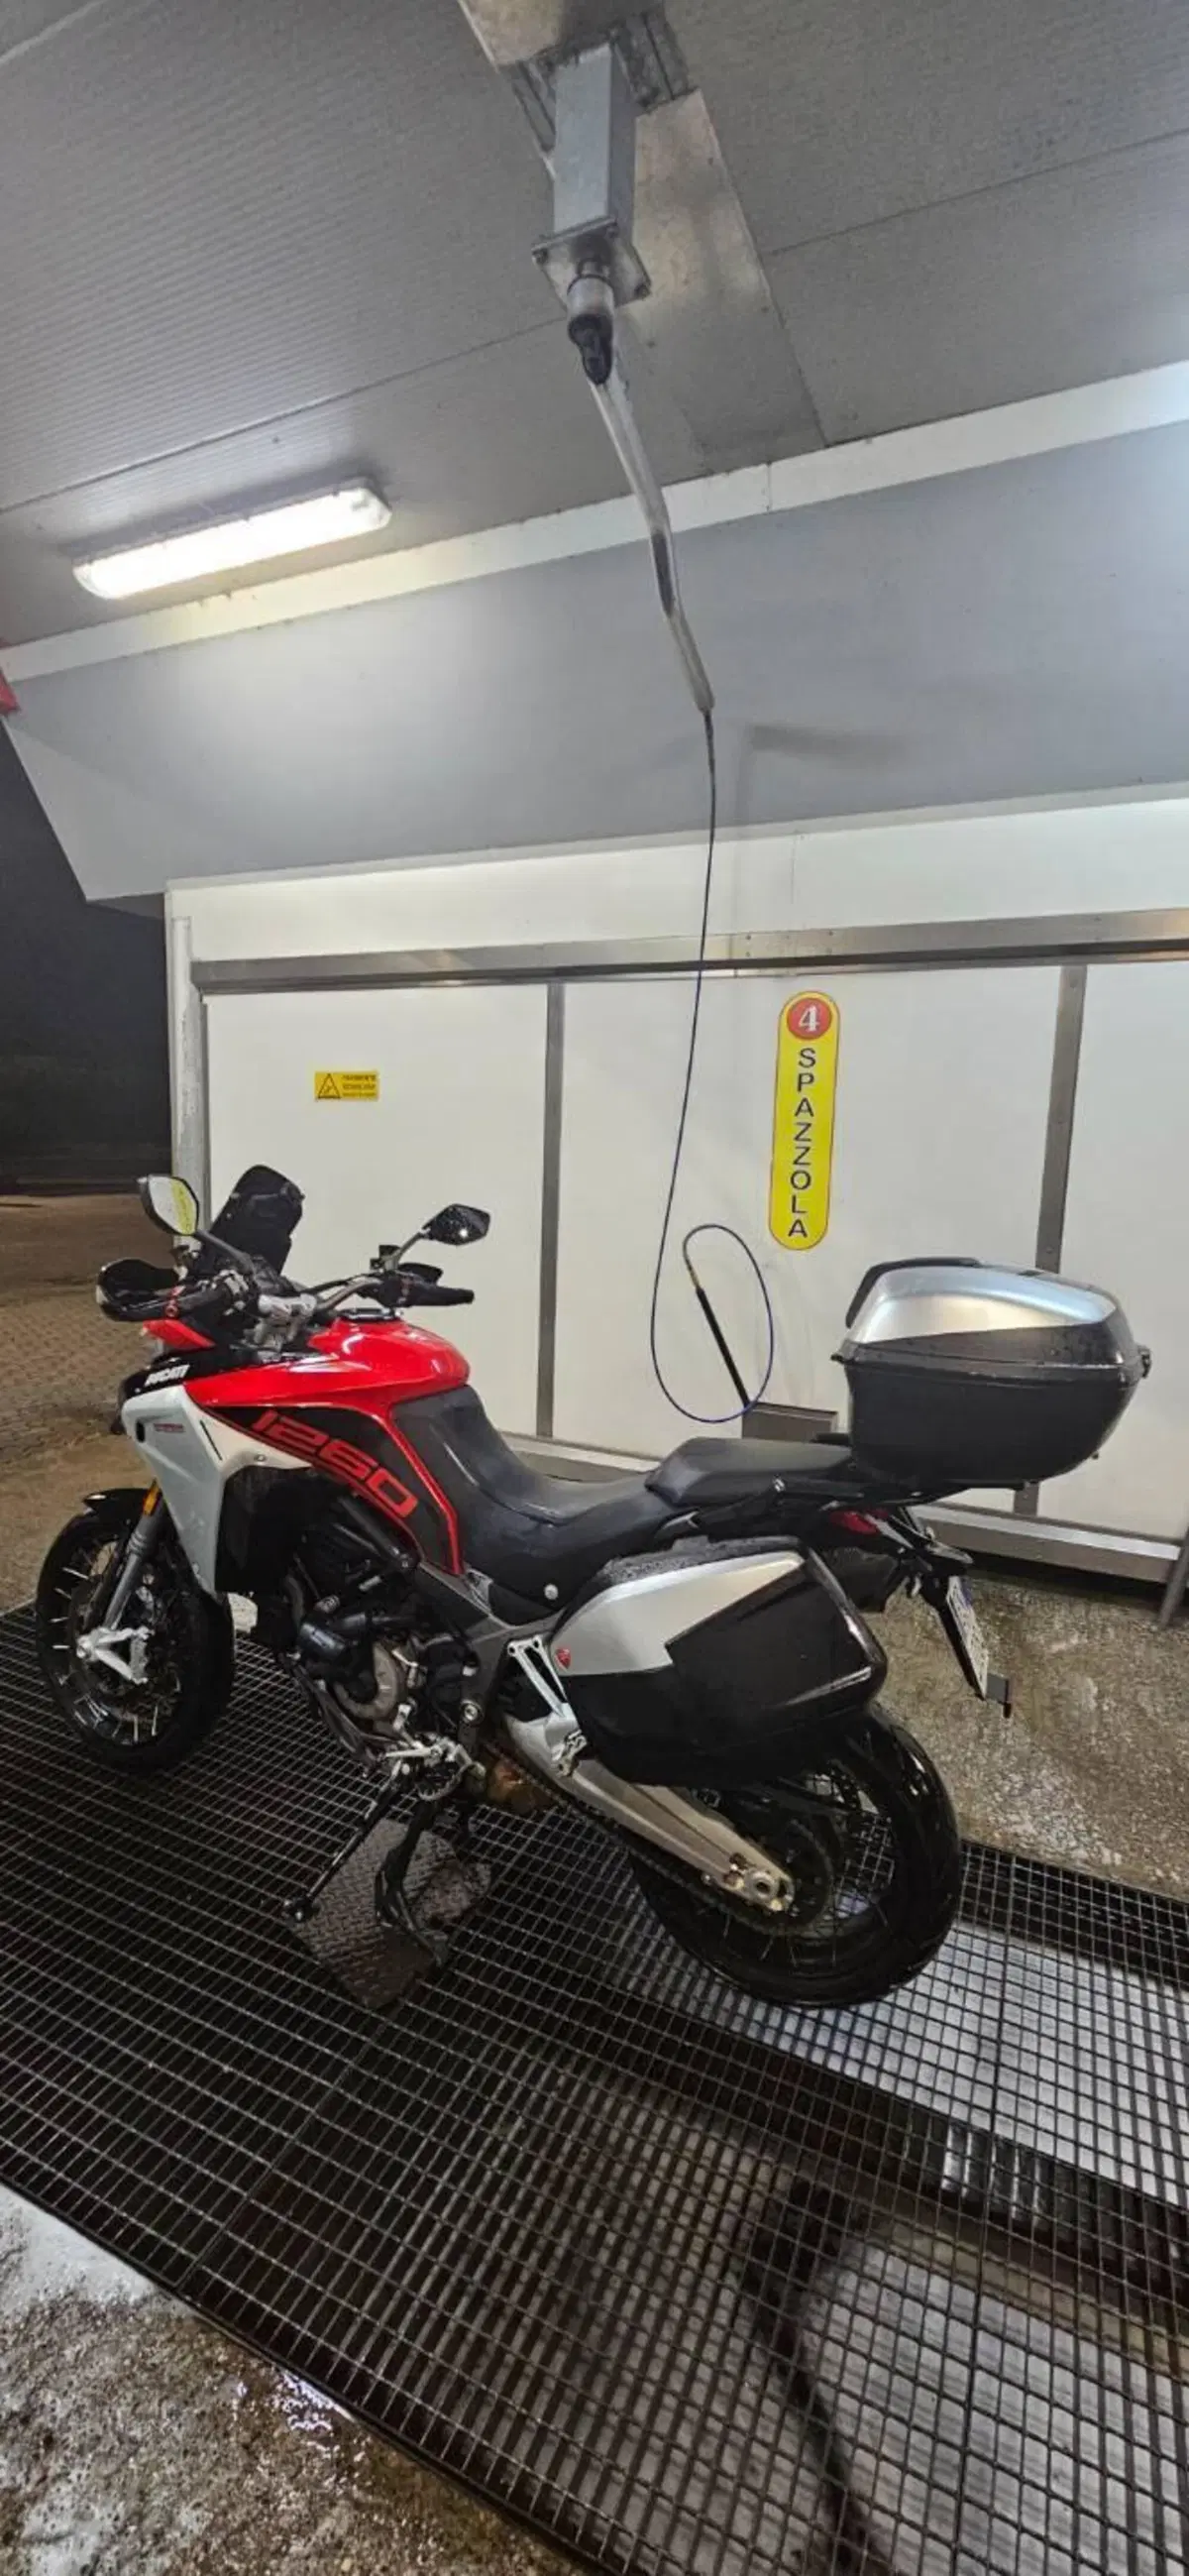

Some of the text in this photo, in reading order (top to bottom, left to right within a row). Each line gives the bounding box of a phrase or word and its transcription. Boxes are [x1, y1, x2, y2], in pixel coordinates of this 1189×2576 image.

[799, 1005, 820, 1032] 4
[788, 1048, 816, 1237] SPAZZOLA
[144, 1364, 190, 1387] DUCATI
[252, 1409, 418, 1517] 1260
